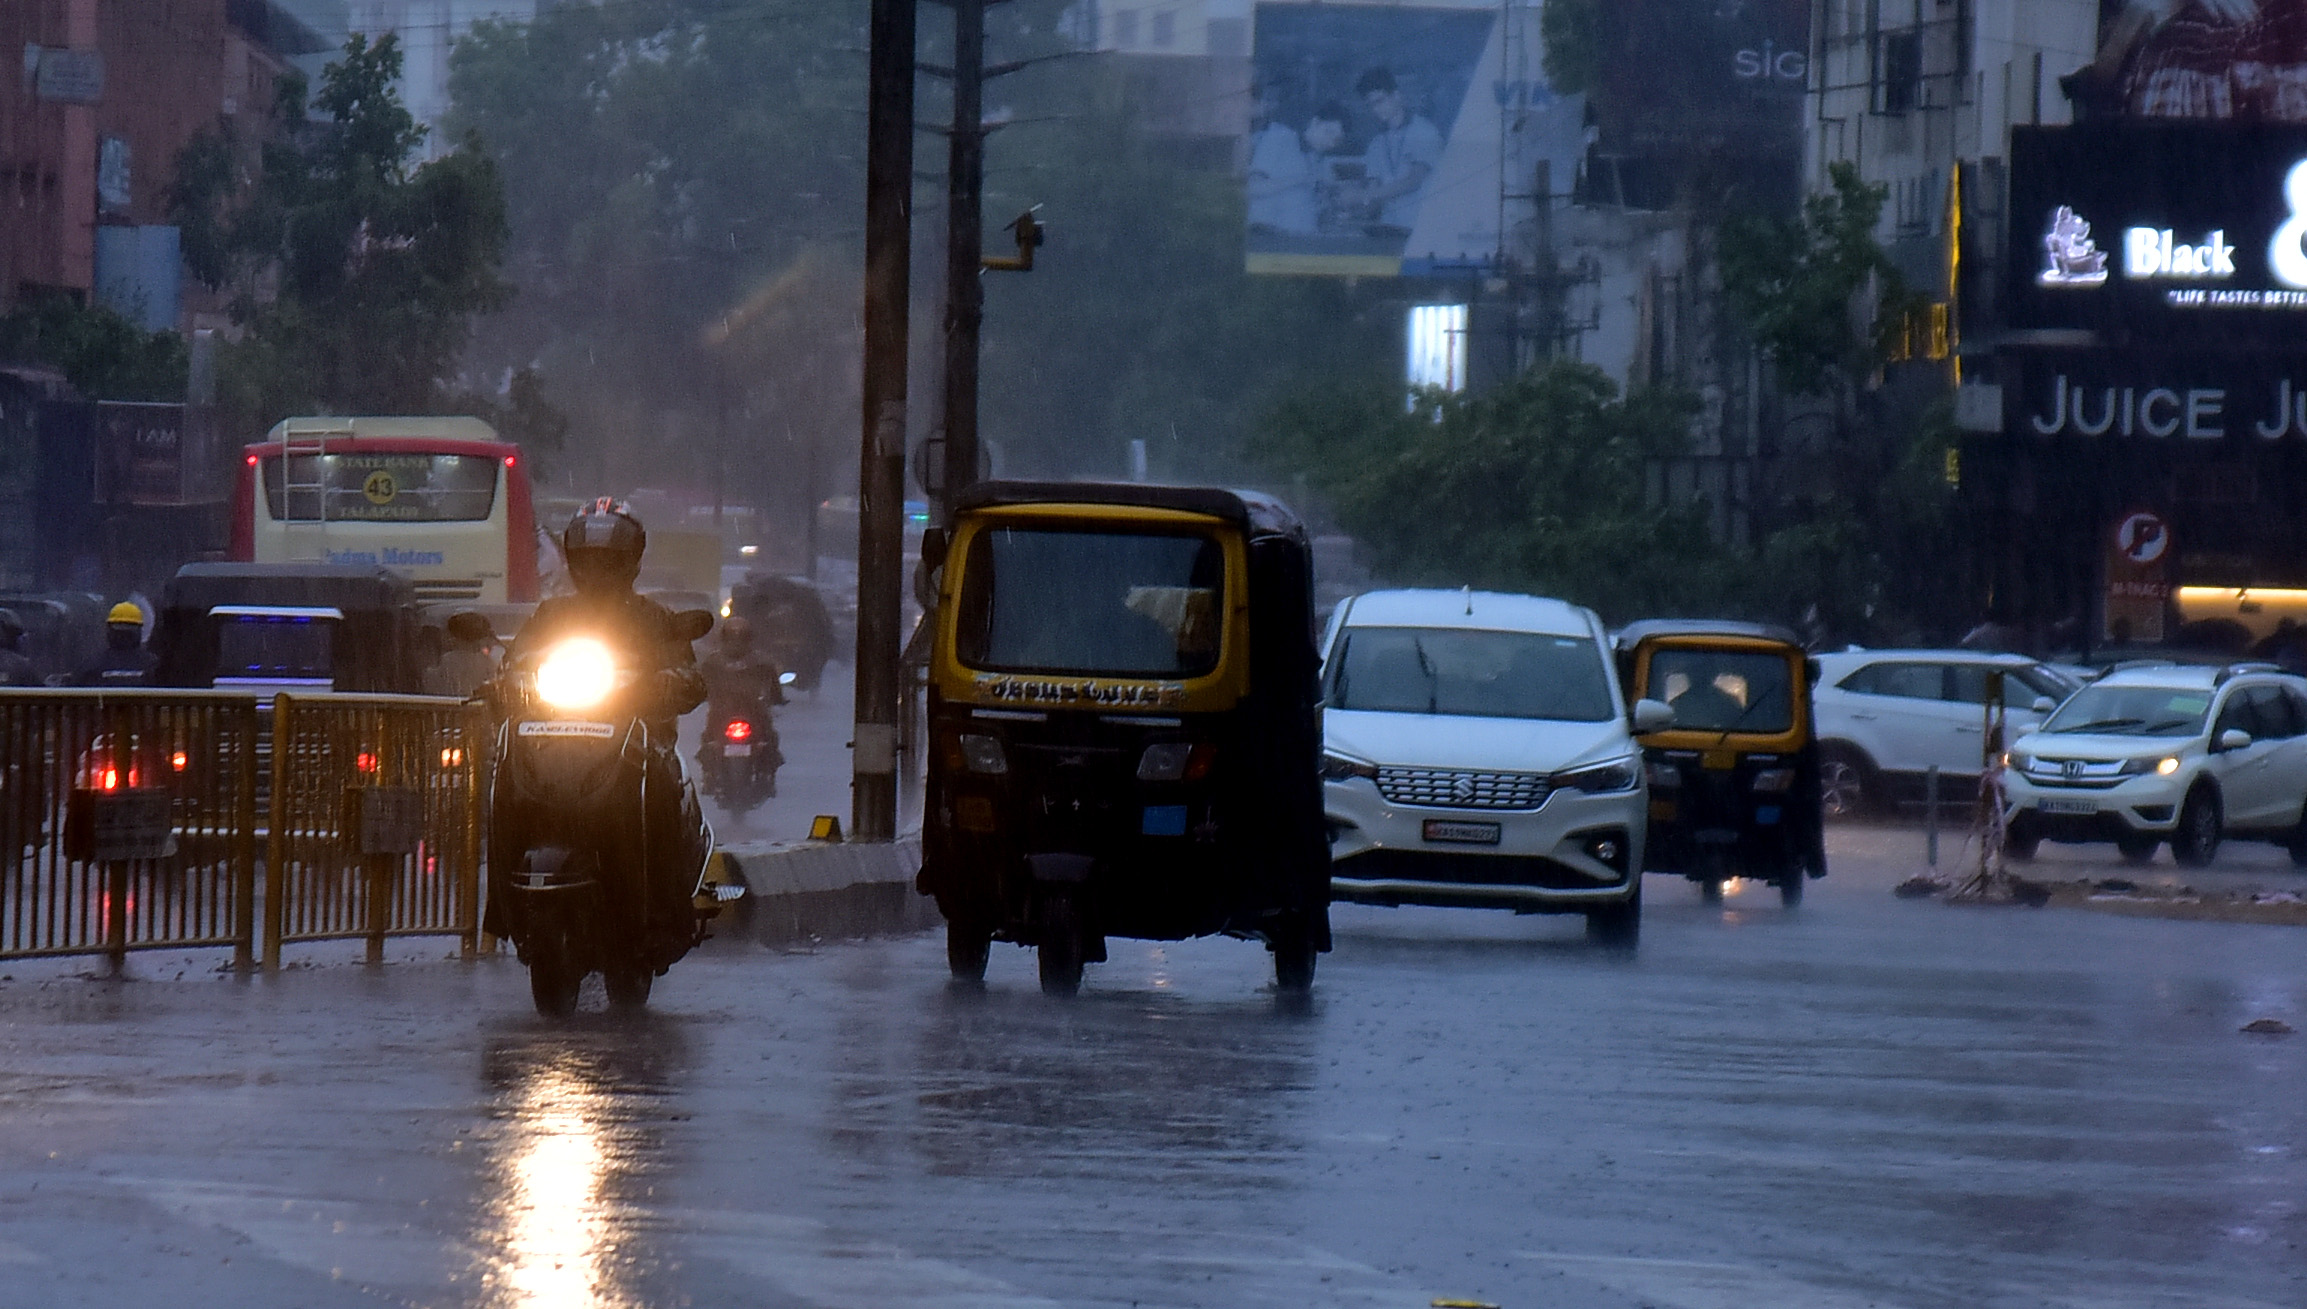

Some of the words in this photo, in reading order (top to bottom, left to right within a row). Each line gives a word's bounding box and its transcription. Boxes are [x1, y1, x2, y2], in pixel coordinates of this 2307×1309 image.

[2129, 226, 2236, 274] Black
[2211, 290, 2260, 303] TASTES
[2032, 375, 2225, 439] JUICE
[145, 429, 177, 445] AM
[368, 478, 393, 498] 43
[382, 547, 444, 565] Motors
